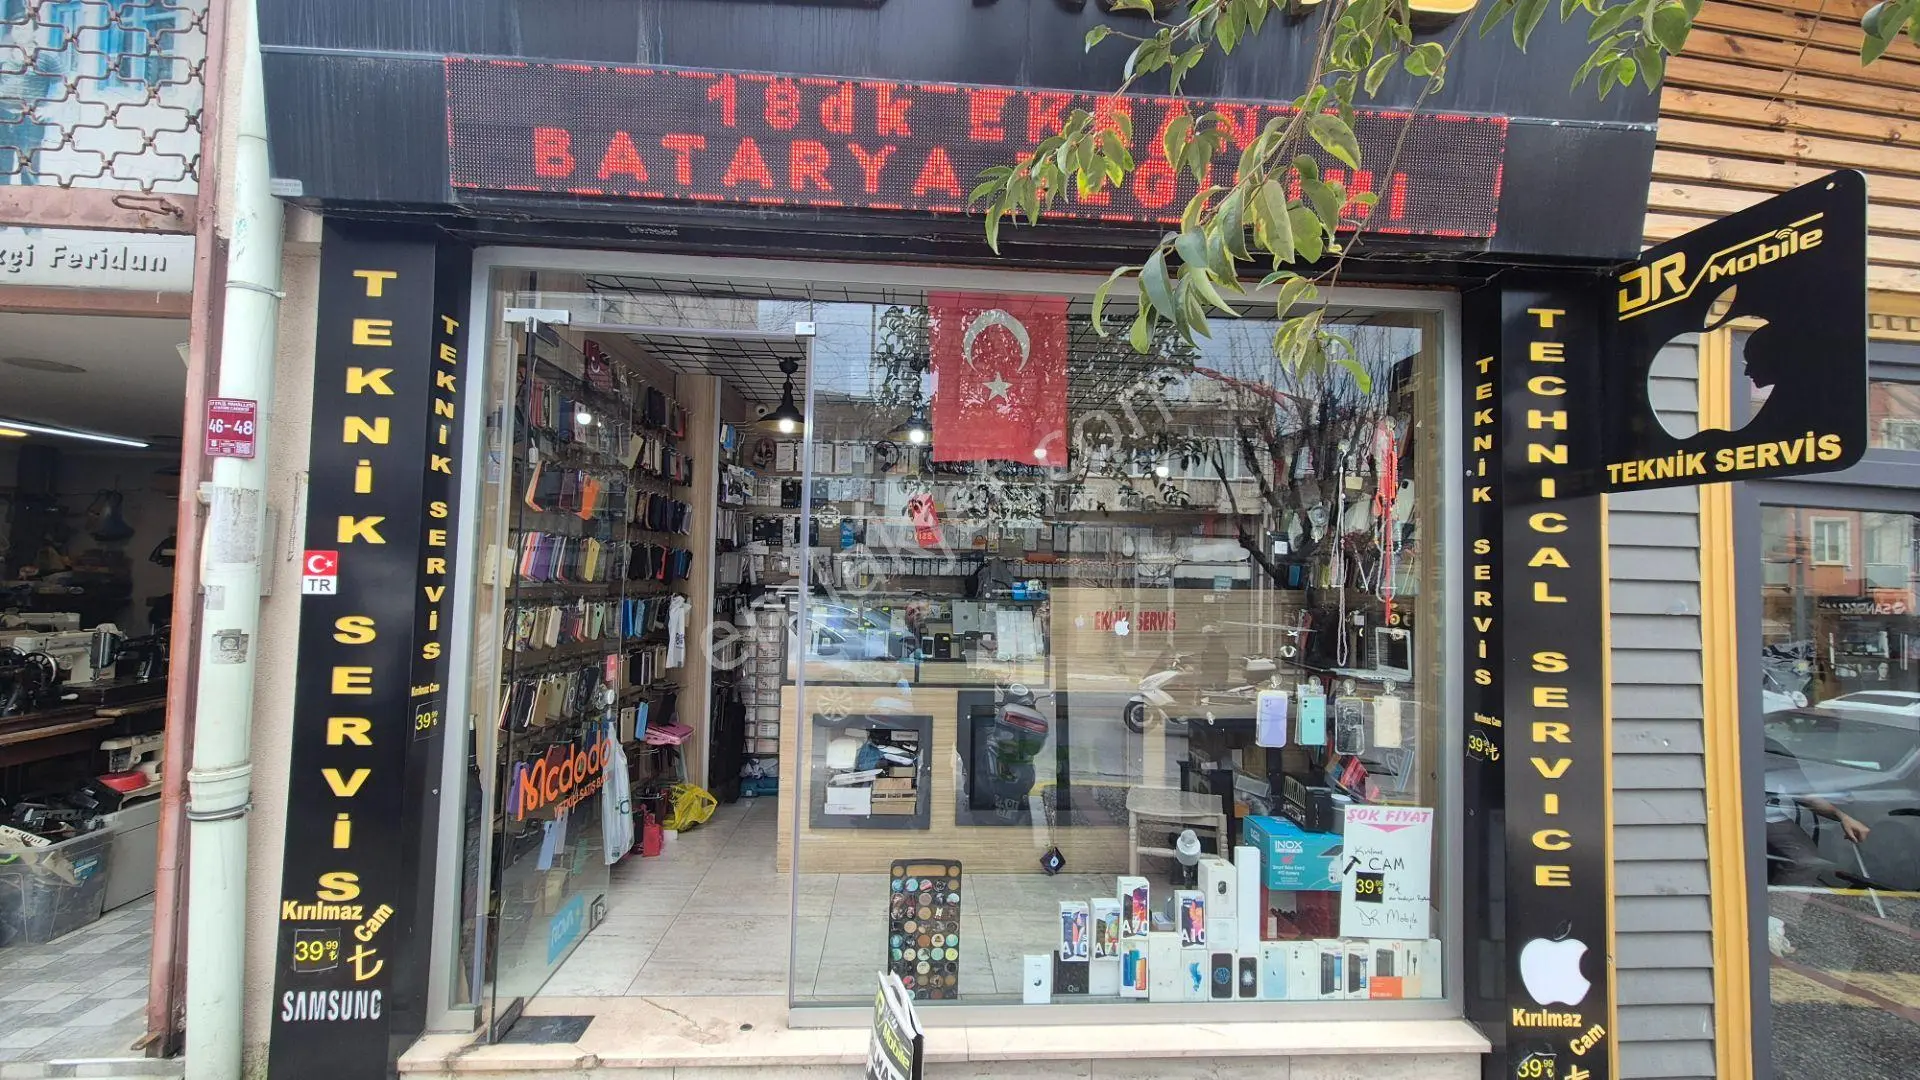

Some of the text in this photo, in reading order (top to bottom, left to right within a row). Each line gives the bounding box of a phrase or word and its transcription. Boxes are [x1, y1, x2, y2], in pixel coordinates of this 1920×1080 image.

[533, 126, 963, 199] BATARYA
[49, 246, 168, 272] Feridun
[1618, 228, 1824, 313] DR Mobile
[209, 418, 253, 436] 46-48
[1606, 431, 1843, 484] TEKNİK SERVİS
[423, 315, 460, 660] TEKNİK SERVİS
[1473, 356, 1495, 686] TEKNİK SERVİS
[307, 578, 331, 592] TR
[316, 270, 397, 902] TEKNİK SERVİS
[1527, 308, 1573, 887] TECHNICAL SERVICE
[516, 729, 612, 822] Mcdodo
[1346, 808, 1432, 824] ŞOK FİYAT
[1274, 840, 1304, 849] INOX
[1368, 857, 1405, 871] CAM
[281, 900, 363, 921] Kırılmaz
[281, 988, 383, 1023] SAMSUNG
[1512, 1007, 1583, 1028] Kırılmaz
